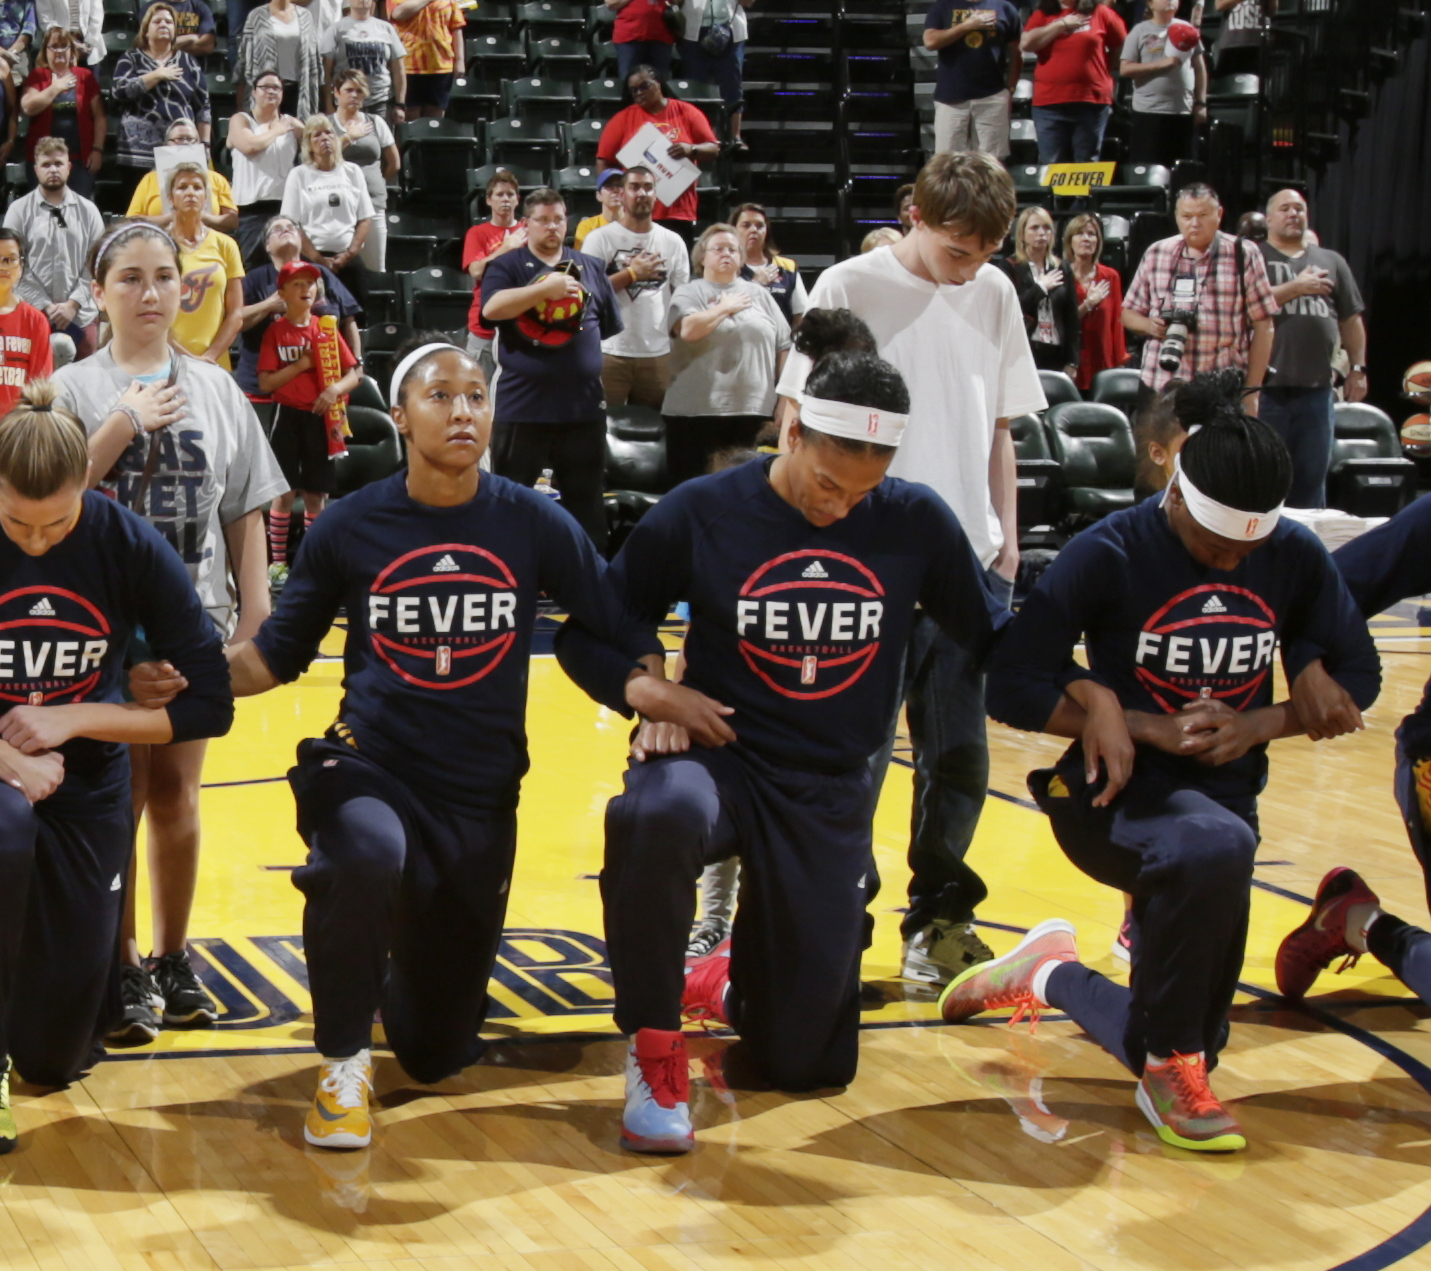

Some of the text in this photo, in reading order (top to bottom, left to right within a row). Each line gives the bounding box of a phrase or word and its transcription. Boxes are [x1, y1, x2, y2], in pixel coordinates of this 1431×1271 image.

[1050, 171, 1105, 186] GO FEVER
[433, 564, 460, 573] adidas
[28, 607, 56, 616] adidas
[369, 591, 517, 633] FEVER
[1201, 605, 1227, 614] adidas
[736, 599, 885, 641] FEVER
[403, 636, 487, 645] BASKETBALL
[770, 645, 852, 654] BASKETBALL
[1135, 629, 1276, 675] FEVER
[1169, 676, 1246, 686] BASKETBALL
